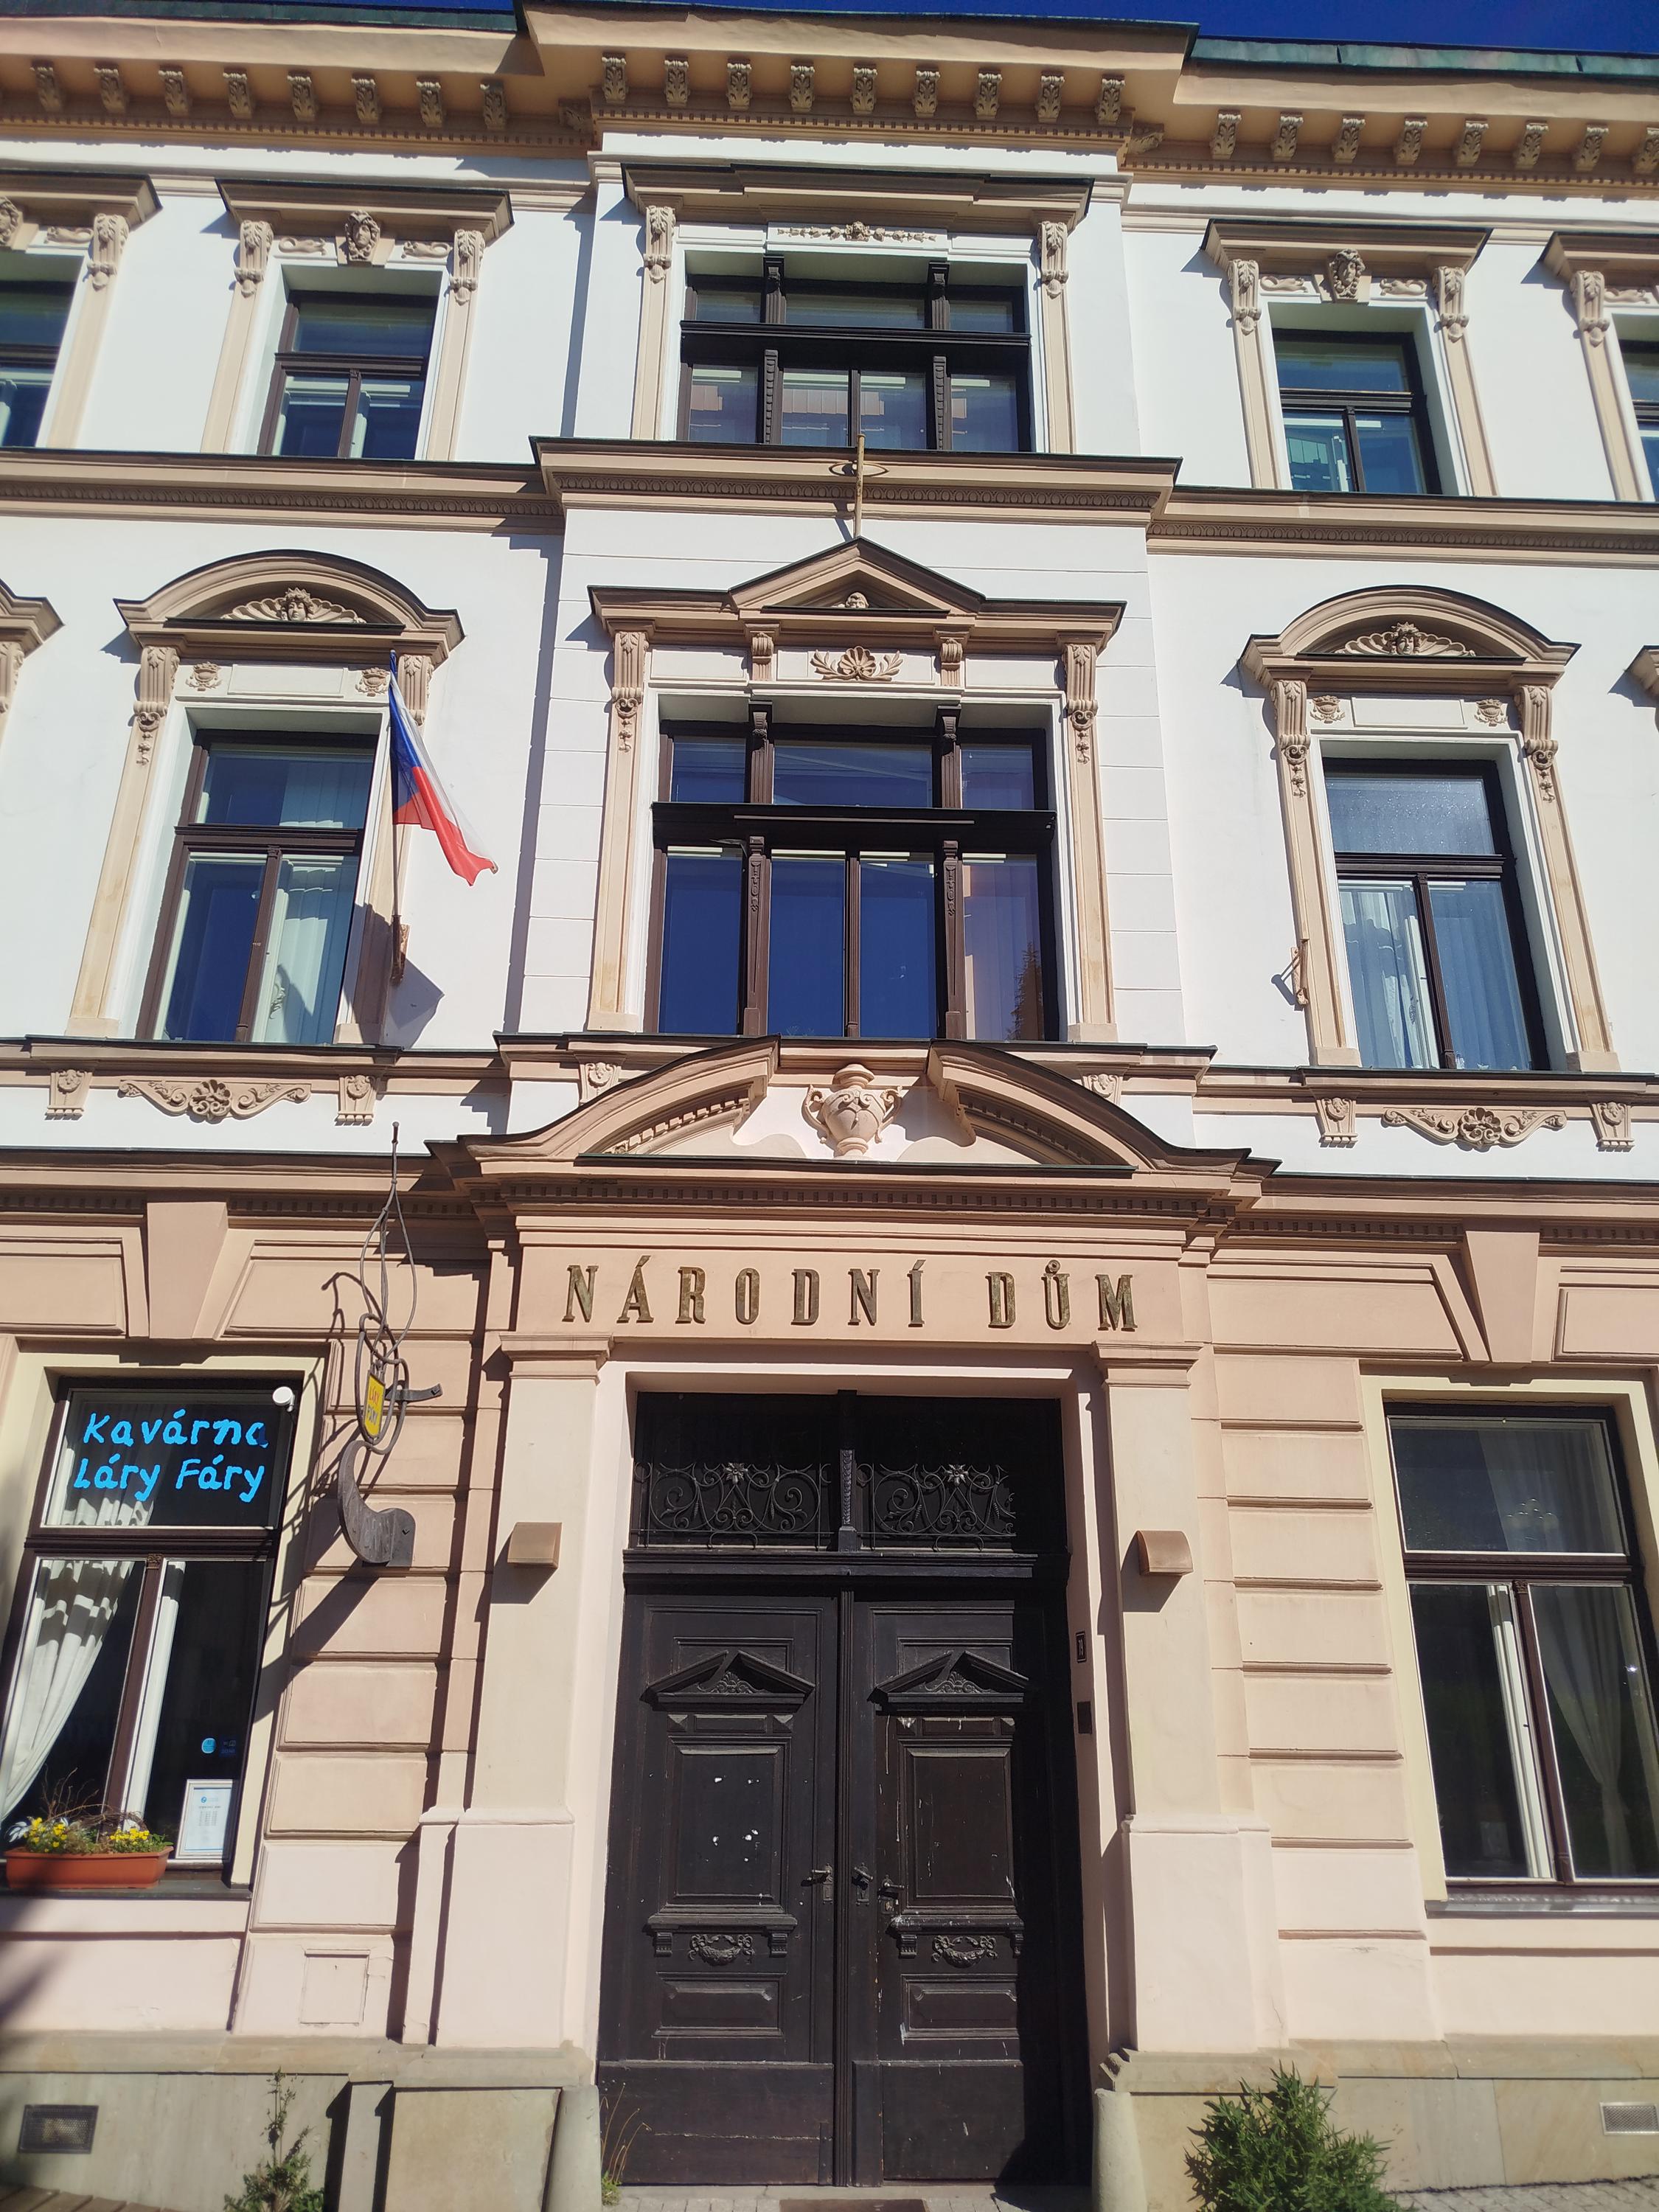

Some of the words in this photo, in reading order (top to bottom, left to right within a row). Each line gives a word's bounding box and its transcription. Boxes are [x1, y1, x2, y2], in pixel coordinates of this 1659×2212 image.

[562, 1255, 927, 1328] NÁRODNÍ
[985, 1259, 1138, 1332] DŮM
[83, 1408, 269, 1449] Kavárna
[73, 1453, 161, 1503] Láry
[175, 1454, 265, 1503] Fáry
